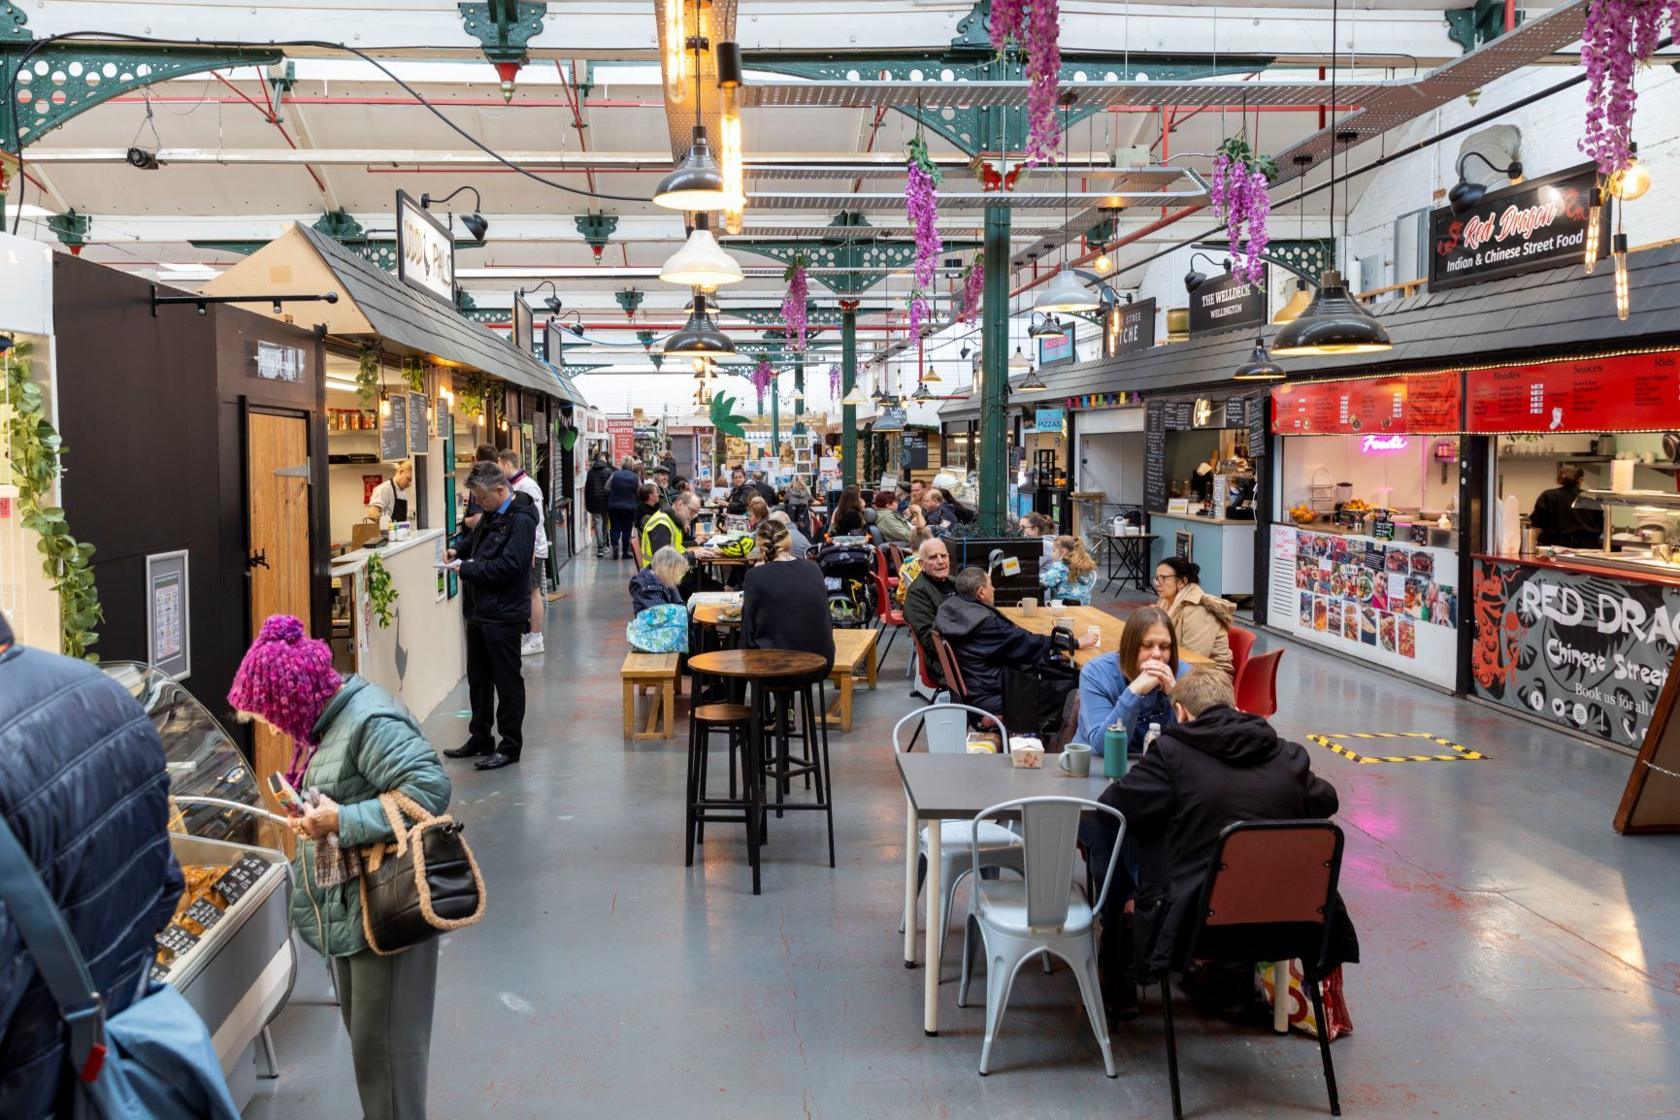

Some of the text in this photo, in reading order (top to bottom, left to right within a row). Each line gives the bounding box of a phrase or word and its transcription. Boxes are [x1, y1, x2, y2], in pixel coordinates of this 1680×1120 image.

[1463, 202, 1558, 249] Red Dragon
[1447, 229, 1584, 272] Indian & Chinese Street Food
[1202, 283, 1251, 307] THE WELLDECK
[1210, 303, 1242, 319] WELLINGTON
[1037, 420, 1062, 428] PIZZAS
[1522, 580, 1680, 645] RED DRA
[1546, 638, 1668, 687] Chinese Street
[1575, 682, 1601, 701] Book
[1603, 694, 1616, 706] us
[1618, 694, 1634, 710] for
[1635, 700, 1649, 715] all
